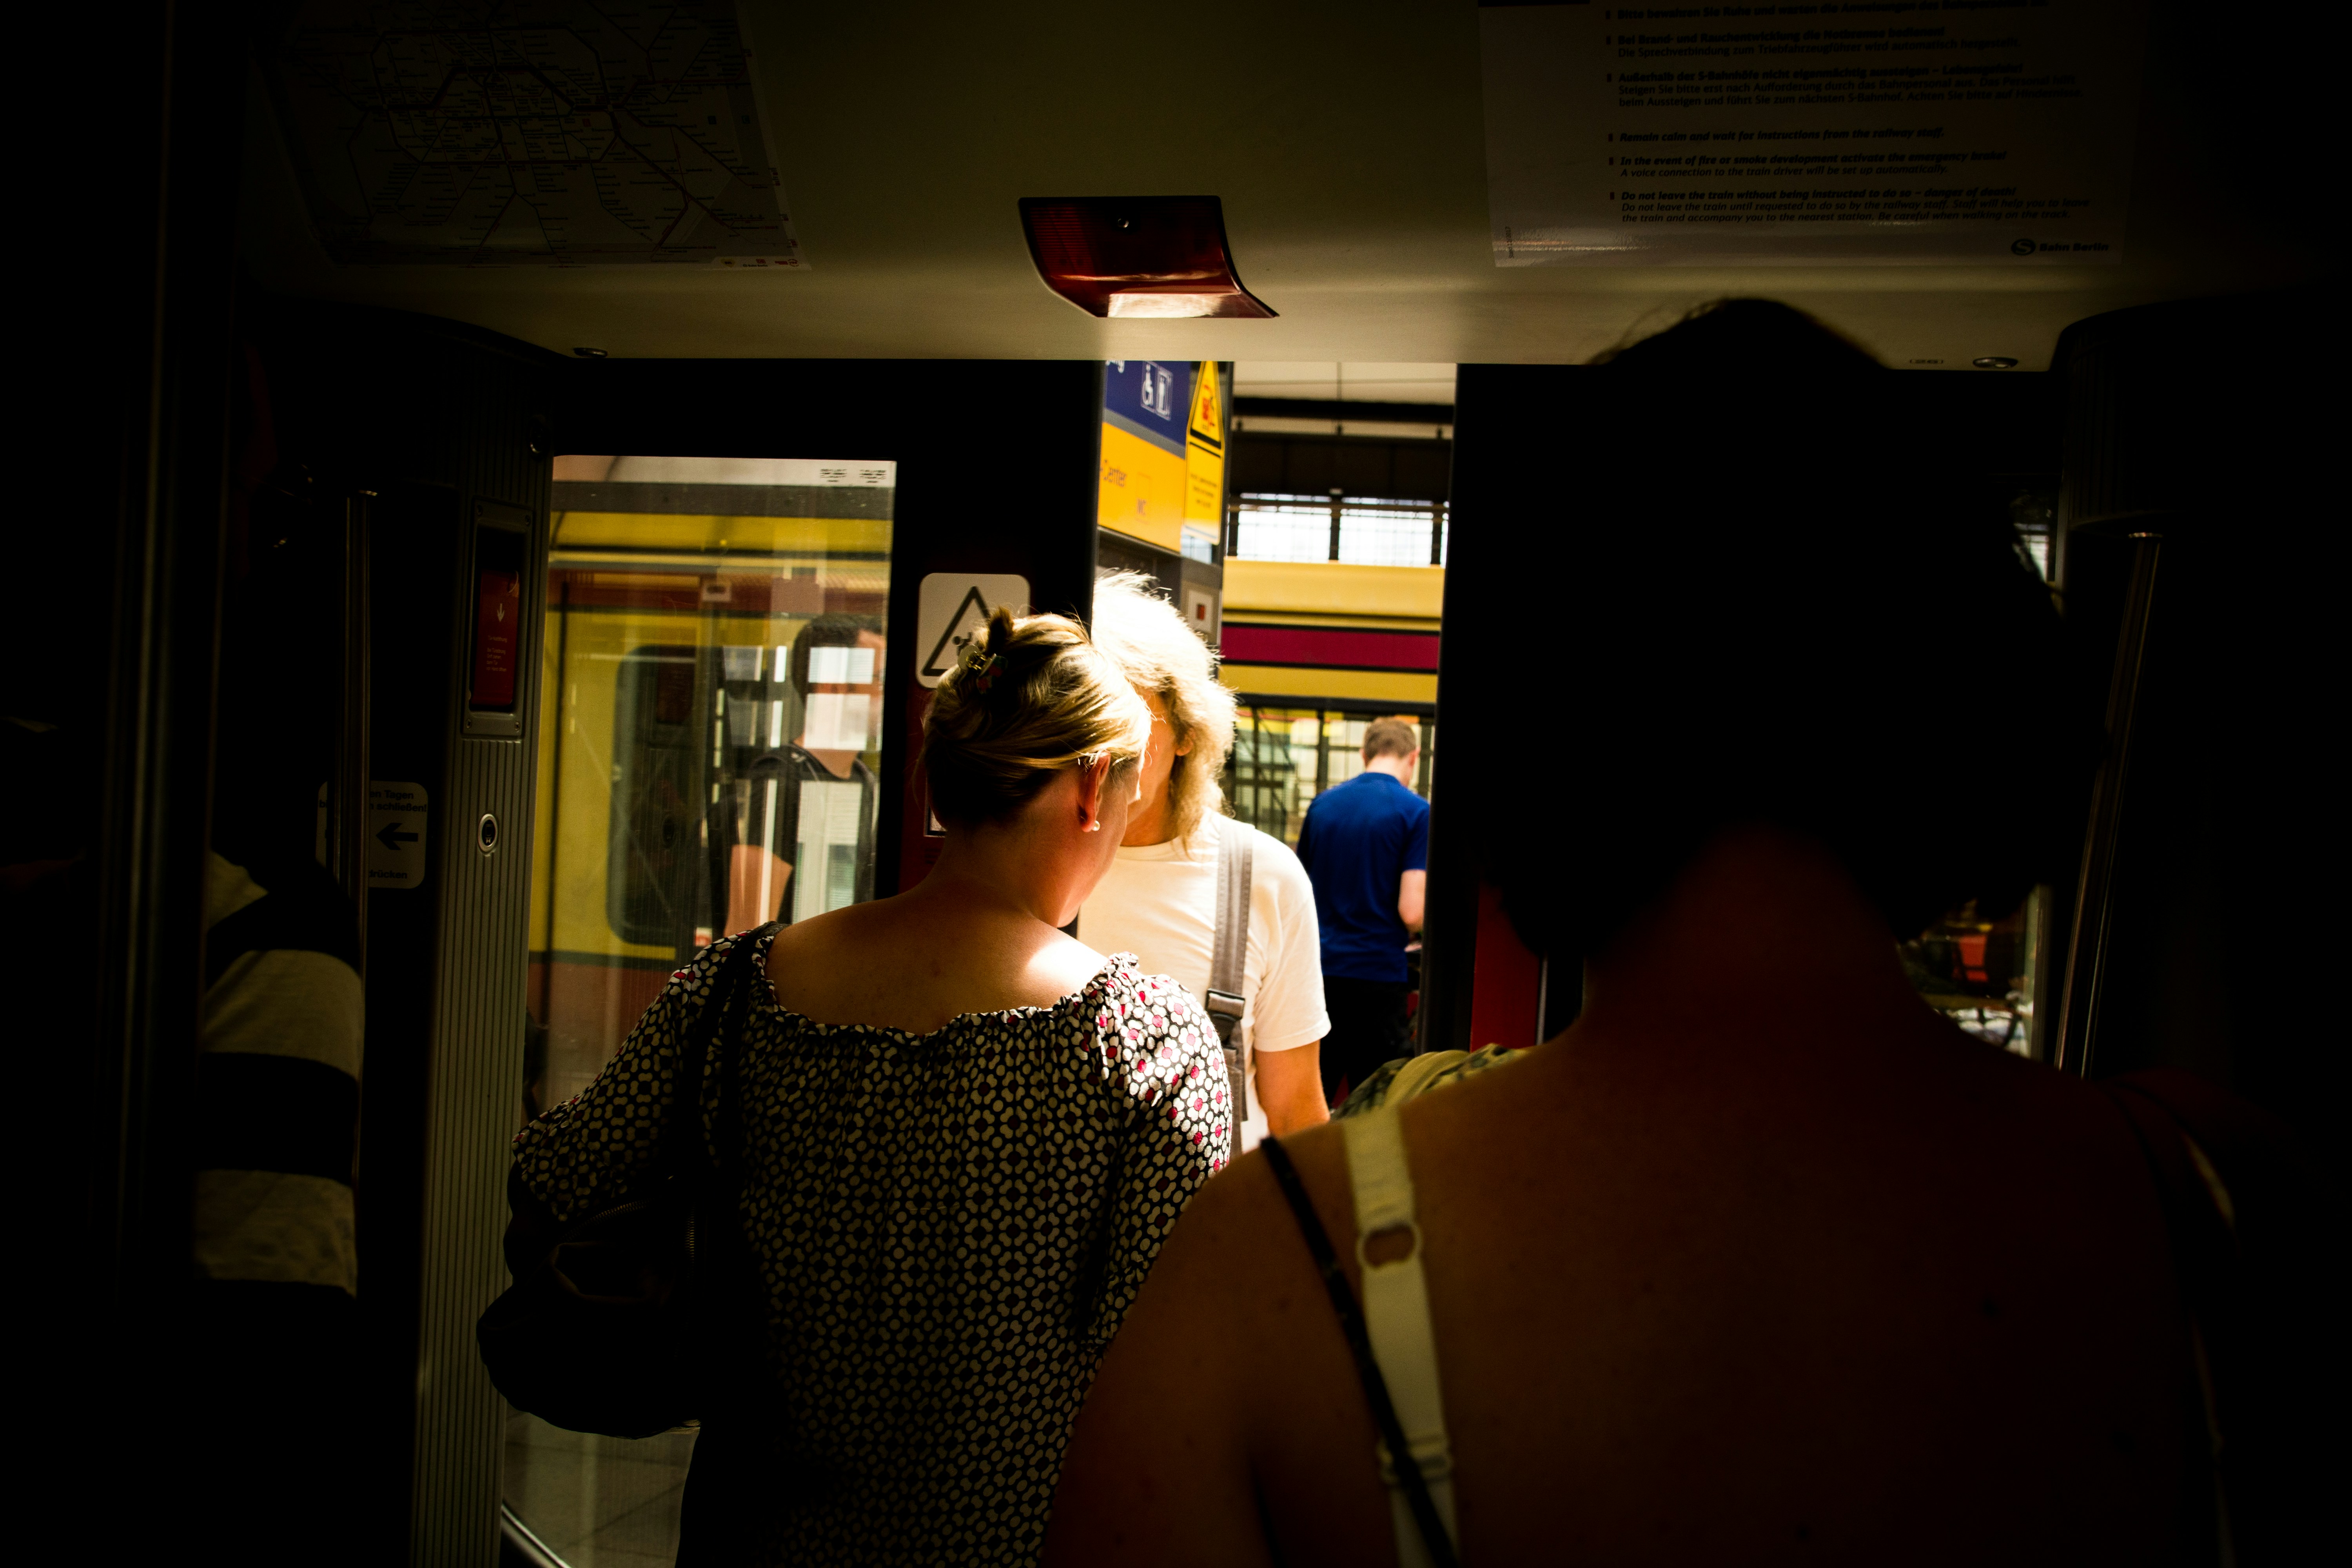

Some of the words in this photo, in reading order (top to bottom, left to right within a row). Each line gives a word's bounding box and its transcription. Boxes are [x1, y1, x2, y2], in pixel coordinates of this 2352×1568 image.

[1617, 9, 1644, 20] Bitte
[1647, 8, 1700, 19] bewahren
[1703, 7, 1720, 17] Sie
[1723, 6, 1751, 16] Ruhe
[1754, 5, 1776, 15] und
[1820, 4, 1838, 13] die
[1919, 1, 1938, 10] des
[1617, 35, 1635, 45] Bei
[1638, 34, 1673, 44] Brand-
[1676, 33, 1698, 44] und
[1700, 31, 1800, 43] Rauchentwicklung
[1803, 30, 1821, 40] die
[1618, 48, 1635, 58] Die
[1639, 46, 1730, 58] Sprechverbindung
[1733, 47, 1754, 55] zum
[1759, 43, 1862, 54] Triebfahrzeugführer
[1865, 41, 1889, 51] wird
[1892, 38, 1958, 51] automatisch
[1960, 37, 2021, 51] hergestellt.
[1619, 72, 1674, 82] Außerhalb
[1677, 71, 1695, 81] der
[1698, 70, 1759, 80] S-Bahnhöfe
[1762, 69, 1790, 79] nicht
[1793, 67, 1867, 80] eigenmächtig
[1619, 85, 1655, 96] Steigen
[1659, 85, 1673, 94] Sie
[1677, 85, 1700, 93] bitte
[1726, 83, 1750, 93] nach
[1754, 82, 1822, 92] Aufforderung
[1825, 81, 1855, 90] durch
[1858, 81, 1875, 89] das
[1955, 80, 1976, 88] Bahnpersonal
[1980, 77, 1999, 86] Das
[2003, 75, 2050, 85] Personal
[2053, 74, 2076, 85] hilft
[1619, 98, 1644, 107] beim
[1647, 97, 1701, 108] Aussteigen
[1704, 96, 1724, 105] und
[1727, 95, 1752, 105] führt
[1755, 95, 1771, 104] Sie
[1774, 96, 1795, 104] zum
[1798, 94, 1845, 103] nächsten
[1848, 92, 1903, 102] S-Bahnhof.
[1907, 92, 1945, 101] Achten
[1948, 90, 1964, 100] Sie
[1966, 90, 1993, 100] bitte
[1994, 89, 2013, 99] auf
[2016, 88, 2083, 98] Hindernisse.
[1619, 132, 1660, 142] Remain
[1661, 132, 1687, 141] calm
[1689, 131, 1711, 141] and
[1712, 131, 1736, 140] wait
[1738, 130, 1755, 142] for
[1757, 129, 1820, 140] instructions
[1822, 129, 1850, 141] from
[1852, 129, 1871, 138] the
[1872, 128, 1915, 139] railway
[1916, 126, 1945, 139] staff.
[1620, 156, 1632, 166] In
[1634, 156, 1651, 165] the
[1653, 157, 1682, 165] event
[1685, 155, 1697, 166] of
[1698, 155, 1717, 166] fire
[1733, 155, 1768, 164] smoke
[1769, 154, 1838, 165] development
[1840, 153, 1886, 163] activate
[1887, 152, 1906, 162] the
[1908, 153, 1969, 164] emergency
[1970, 150, 2008, 161] brake!
[1620, 168, 1628, 177] A
[1631, 169, 1656, 177] voice
[1728, 167, 1744, 176] the
[1773, 167, 1803, 175] driver
[1806, 166, 1825, 174] will
[1827, 166, 1840, 175] be
[1860, 167, 1873, 175] up
[1875, 164, 1947, 174] automatically.
[1621, 191, 1636, 200] Do
[1638, 192, 1656, 200] not
[1658, 191, 1686, 200] leave
[1688, 191, 1706, 200] the
[1708, 190, 1734, 199] train
[1737, 190, 1777, 199] without
[1779, 190, 1809, 201] being
[1812, 189, 1867, 198] instructed
[1882, 189, 1897, 198] do
[1924, 188, 1964, 199] danger
[1966, 187, 1979, 198] of
[1980, 186, 2017, 196] death!
[1621, 203, 1635, 212] Do
[1730, 202, 1753, 210] until
[1755, 202, 1804, 212] requested
[1849, 201, 1861, 210] by
[1883, 200, 1921, 210] railway
[1924, 200, 1949, 209] staff.
[1954, 199, 1977, 209] Staff
[1980, 199, 1999, 208] will
[2001, 199, 2024, 209] help
[2026, 200, 2046, 208] you
[2048, 199, 2060, 208] to
[2062, 198, 2091, 207] leave
[1622, 214, 1637, 222] the
[1878, 212, 1891, 220] Be
[1893, 211, 1930, 221] careful
[1962, 211, 2002, 220] walking
[2021, 210, 2038, 219] the
[2041, 209, 2070, 219] track.
[2039, 243, 2070, 252] Bahn
[2073, 242, 2110, 252] Berlin
[384, 790, 414, 800] Tagen
[377, 802, 427, 812] schließen!
[369, 869, 407, 878] drücken
